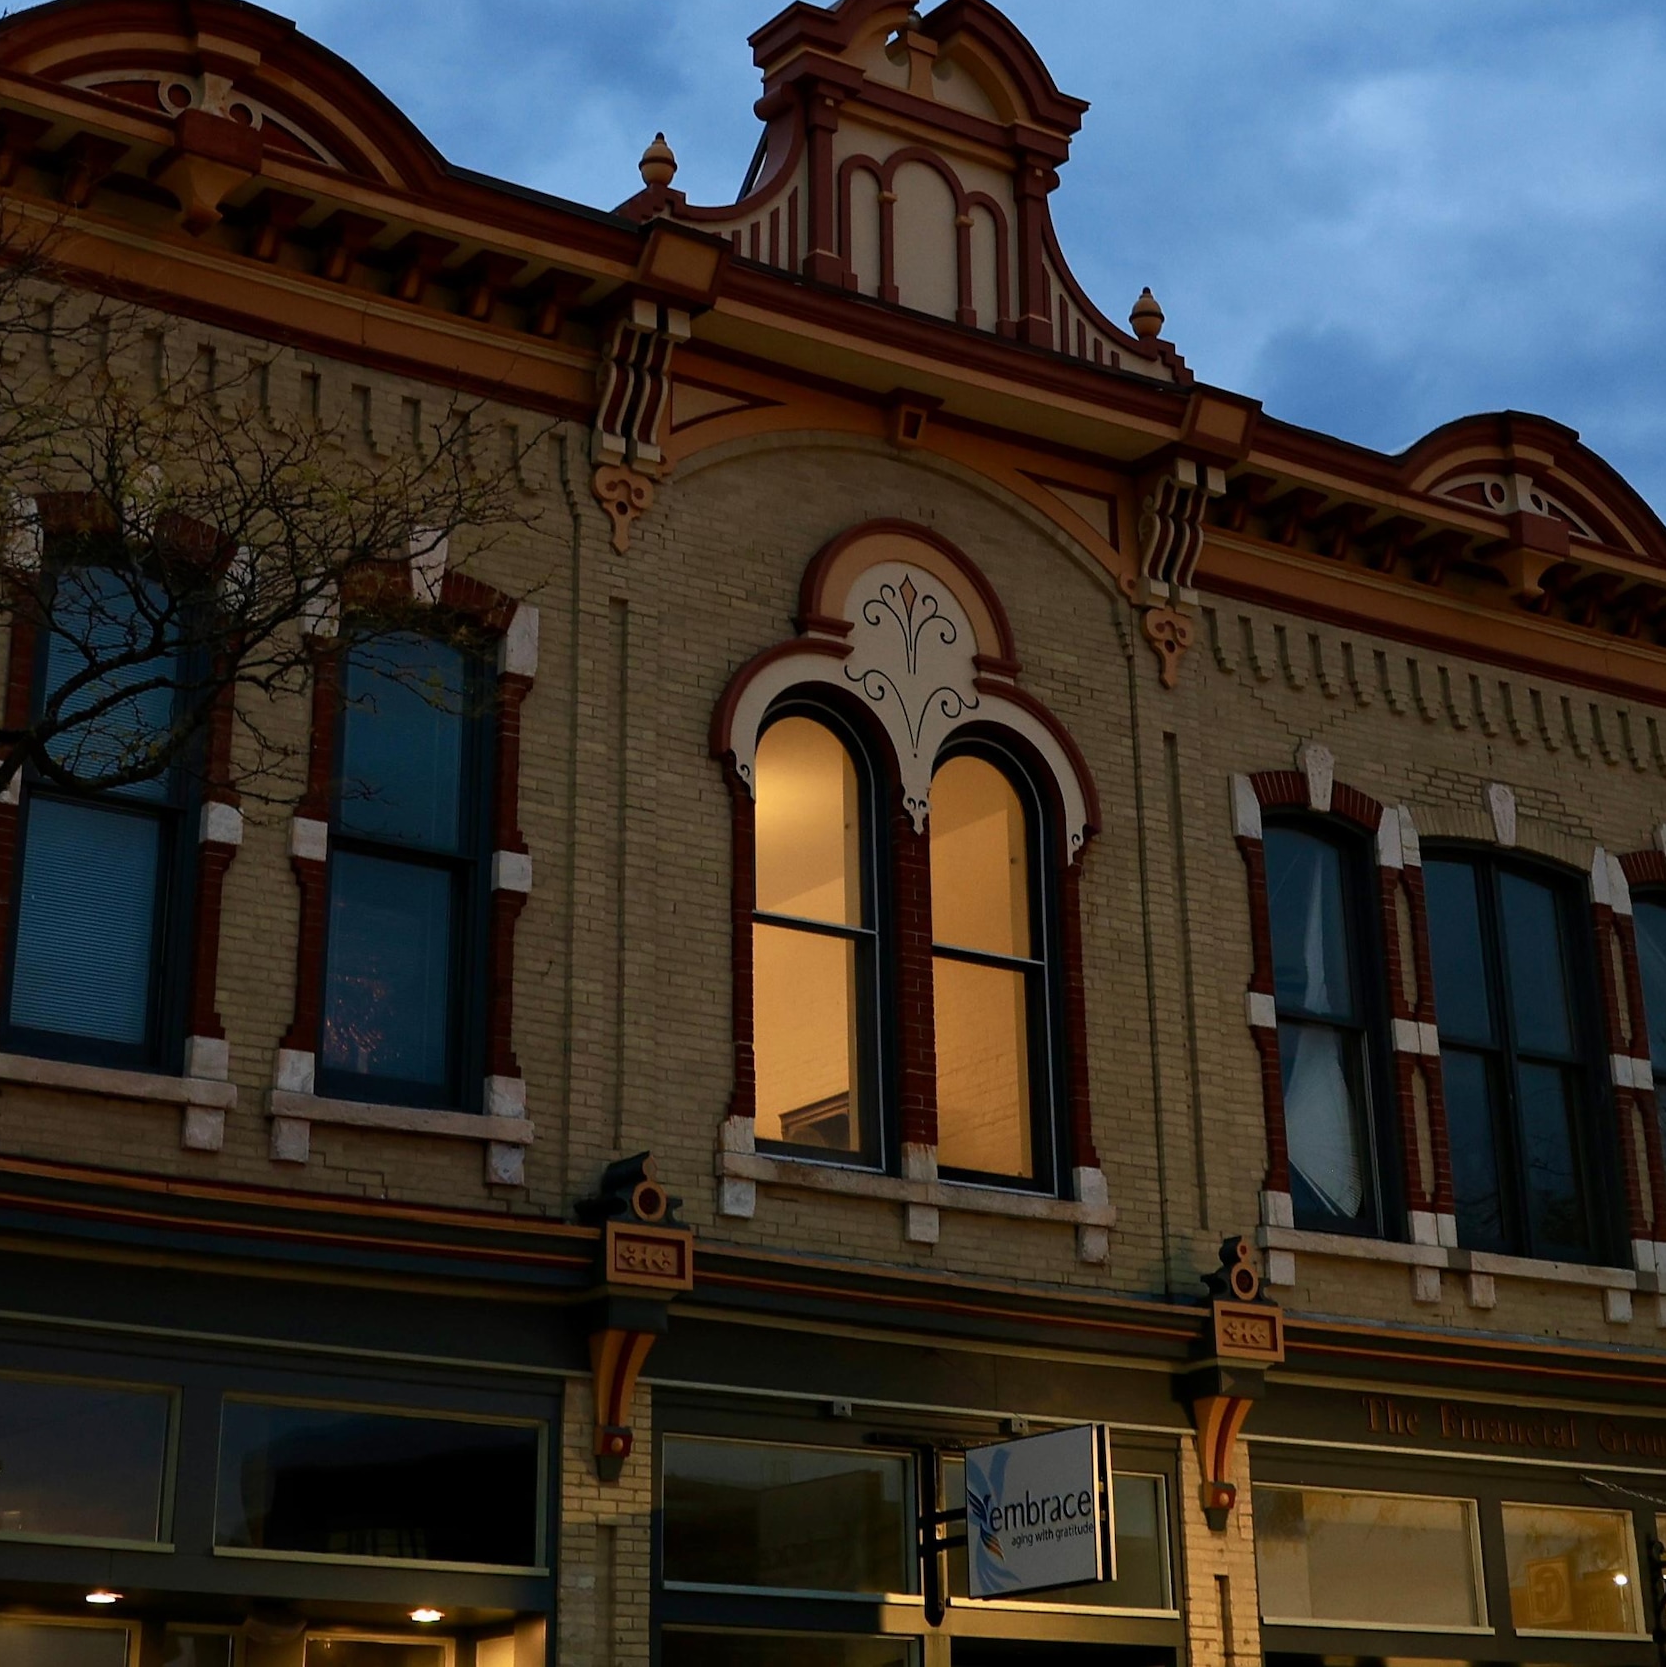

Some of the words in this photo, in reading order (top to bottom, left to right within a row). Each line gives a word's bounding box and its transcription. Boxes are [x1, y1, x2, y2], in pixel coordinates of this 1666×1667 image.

[1359, 1394, 1420, 1438] The
[1438, 1402, 1581, 1452] Financial
[988, 1489, 1093, 1532] embrace
[1010, 1530, 1034, 1549] aging
[1034, 1527, 1054, 1542] with
[1055, 1521, 1094, 1541] gratitude
